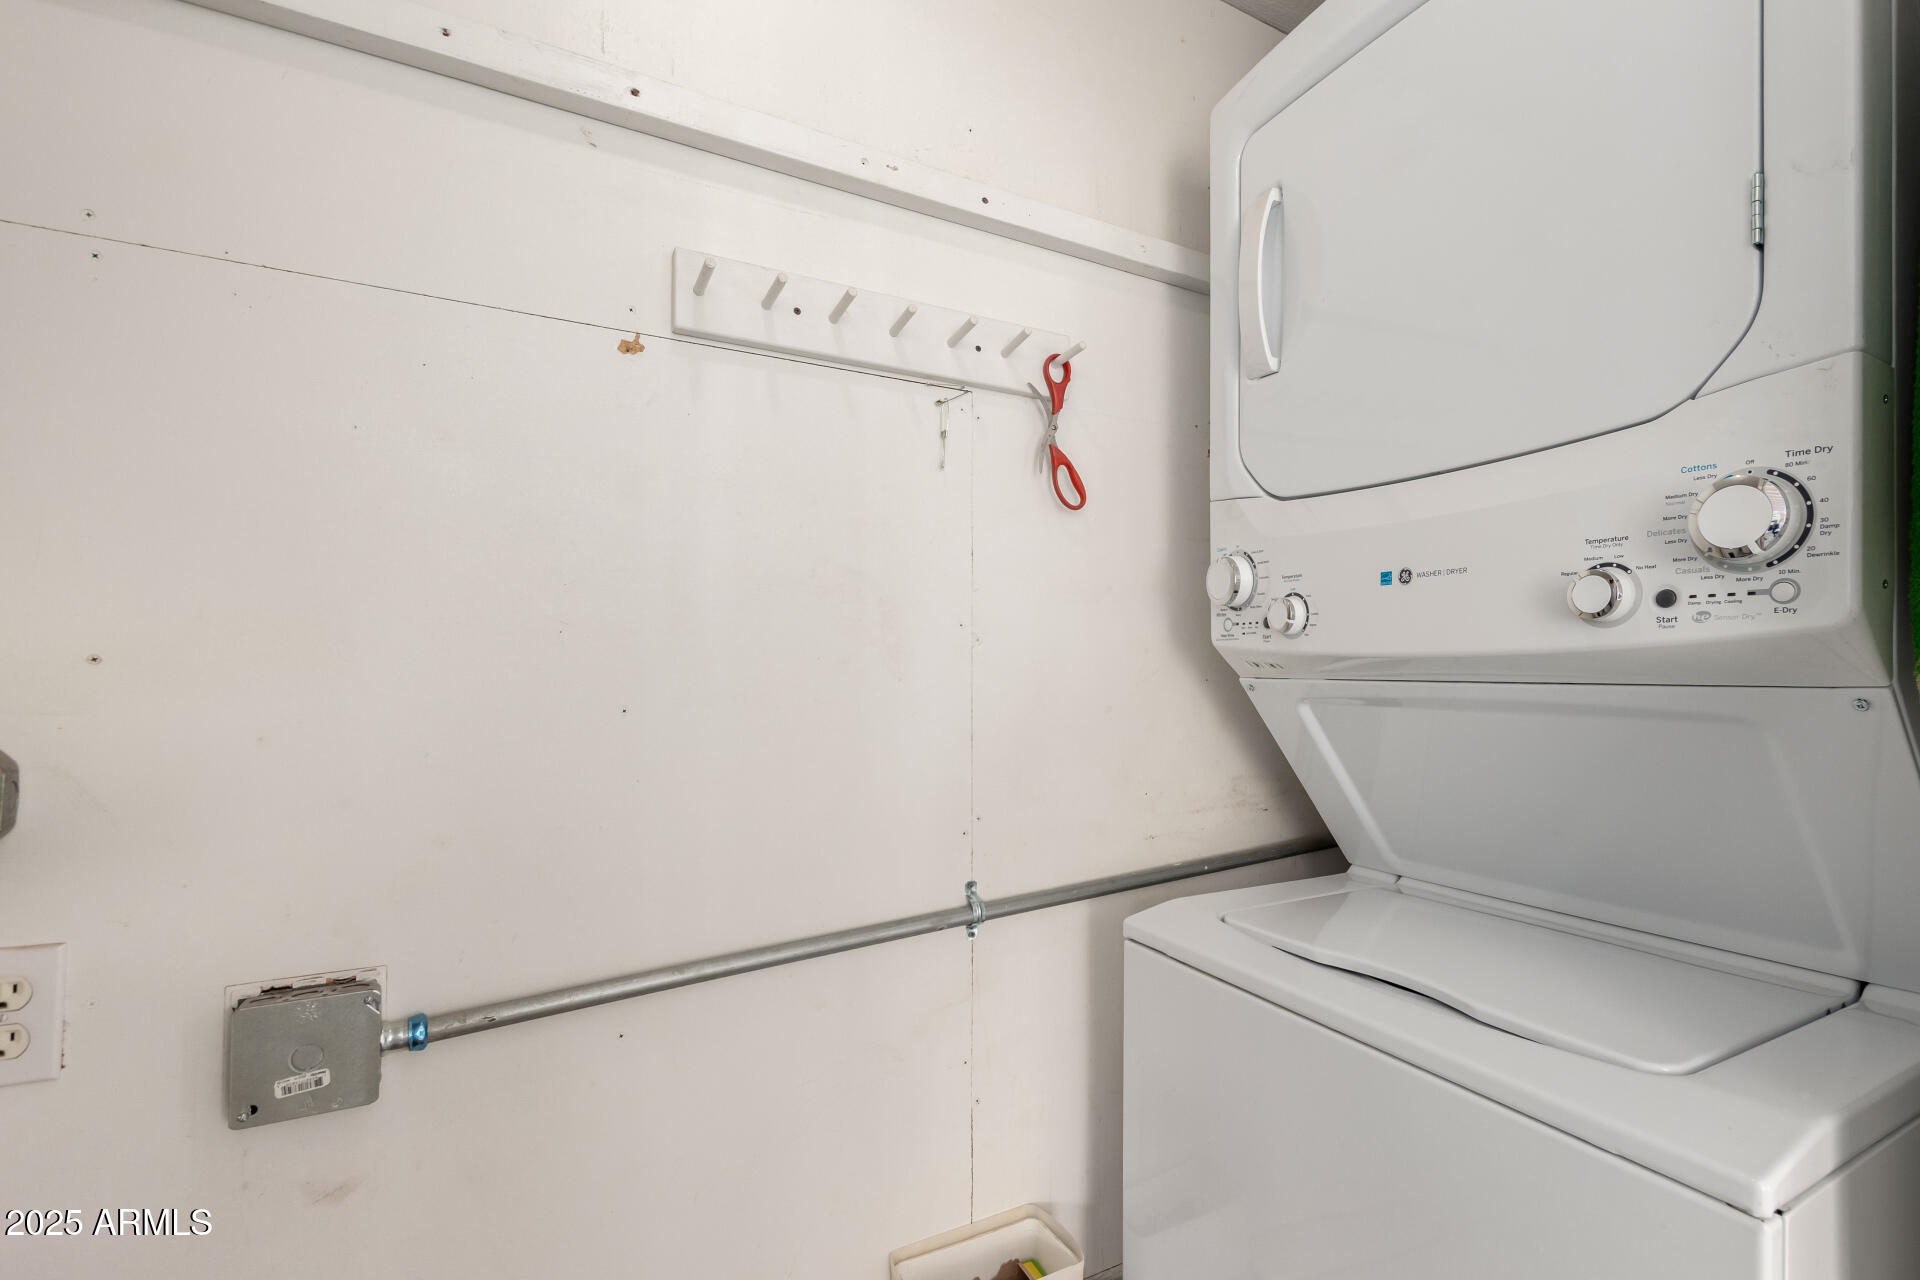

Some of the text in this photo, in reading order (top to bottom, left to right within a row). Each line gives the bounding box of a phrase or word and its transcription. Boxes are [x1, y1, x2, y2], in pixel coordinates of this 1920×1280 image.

[1785, 446, 1834, 457] Time Dry
[1680, 464, 1718, 474] Cottons
[1646, 528, 1686, 538] Delicates
[1585, 536, 1629, 545] Temperature
[1416, 567, 1468, 578] WASHER DRYER
[1675, 566, 1710, 575] Casuals
